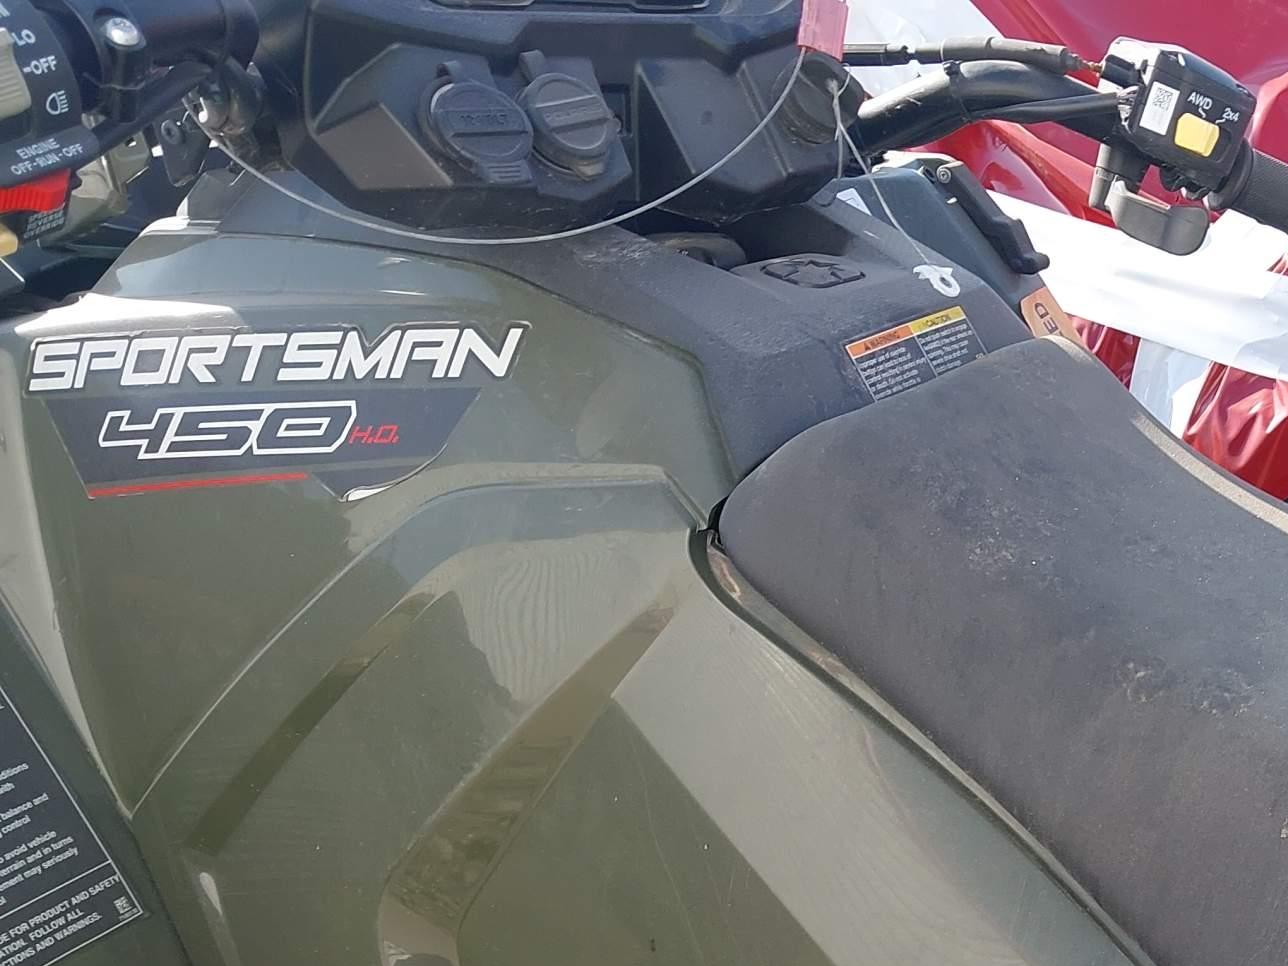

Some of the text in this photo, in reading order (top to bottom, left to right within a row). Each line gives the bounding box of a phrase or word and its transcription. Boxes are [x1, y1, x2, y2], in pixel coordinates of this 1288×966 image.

[11, 29, 36, 46] LO
[1187, 91, 1213, 110] AWD
[16, 138, 60, 160] ENGINE
[28, 327, 524, 392] SPORTSMAN
[98, 400, 357, 461] 450
[1, 814, 32, 834] control
[42, 847, 79, 870] seriously
[9, 922, 30, 938] FOR
[29, 900, 70, 928] PRODUCT
[71, 890, 90, 906] AND
[88, 873, 119, 896] SAFETY
[29, 916, 66, 941] FOLLOW
[66, 908, 84, 922] ALL
[35, 936, 55, 952] AND
